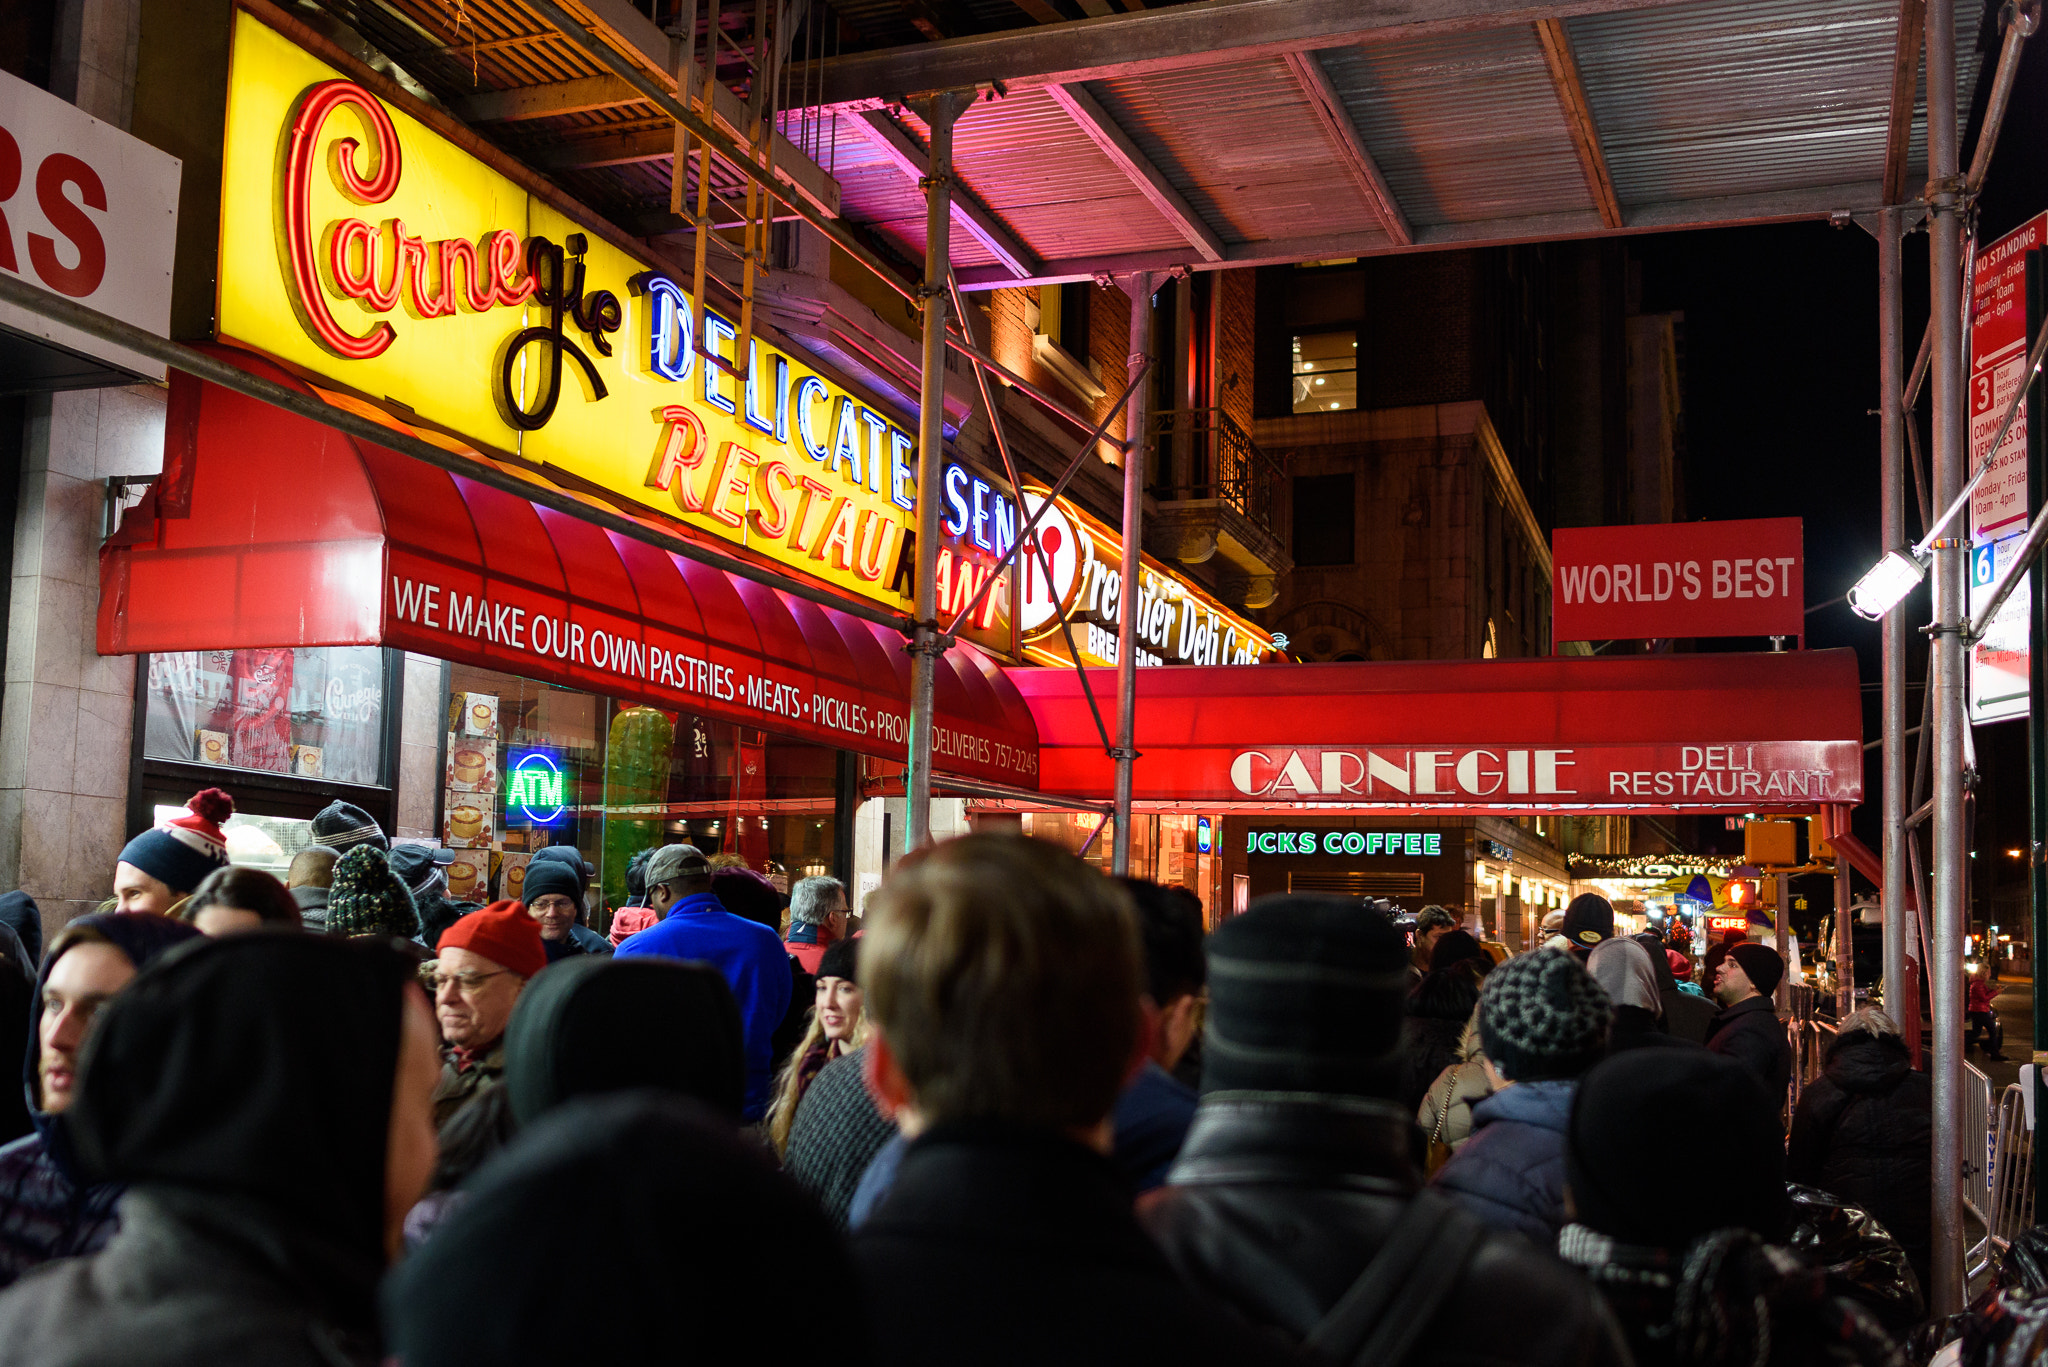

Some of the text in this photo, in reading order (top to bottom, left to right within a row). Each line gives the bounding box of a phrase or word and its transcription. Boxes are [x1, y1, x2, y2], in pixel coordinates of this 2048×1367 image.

[0, 125, 107, 298] S
[274, 79, 622, 431] Carnegie
[1975, 227, 2036, 275] NO STANDING
[1975, 273, 2001, 296] Monday
[2007, 260, 2025, 279] Frida
[1975, 296, 1991, 311] 7am
[1996, 283, 2015, 300] 10am
[1975, 312, 1991, 327] 4pm
[1996, 299, 2013, 317] 6pm
[1996, 367, 2010, 379] hour
[1977, 376, 1990, 410] 3
[1996, 391, 2015, 409] parki
[644, 271, 1015, 565] DELICATESEN
[1974, 404, 2027, 440] COMMEIAL
[1974, 424, 2027, 458] VEHES ON
[1999, 455, 2009, 468] NO
[2010, 448, 2026, 464] STAN
[1975, 481, 2001, 500] Monday
[2008, 471, 2027, 487] Frida
[1975, 501, 1993, 515] 10am
[2000, 492, 2016, 508] 4pm
[1977, 547, 1991, 583] 6
[1997, 543, 2011, 554] hour
[1997, 555, 2013, 567] mete
[1560, 557, 1795, 604] WORLD'S BEST
[1088, 622, 1163, 667] BREAFAS
[1179, 598, 1220, 665] Deli
[1997, 646, 2028, 663] Midnight
[393, 576, 440, 628] WE
[448, 591, 525, 649] MAKE
[531, 614, 585, 664] OUR
[590, 630, 646, 678] OWN
[650, 646, 735, 702] PASTRIES
[747, 674, 801, 718] MEATS
[812, 694, 868, 735] PICKLES
[931, 725, 990, 764] DELIVERIES
[994, 743, 1038, 776] 757-2245
[326, 676, 382, 722] Carnegie
[1229, 748, 1578, 797] CARNEGIE
[1682, 745, 1754, 772] DELI
[508, 769, 563, 806] ATM
[1609, 770, 1832, 797] RESTAURANT
[1323, 832, 1441, 855] COFFEE
[1600, 864, 1730, 877] PARK CENTRAL
[1987, 1133, 1996, 1187] NYPD
